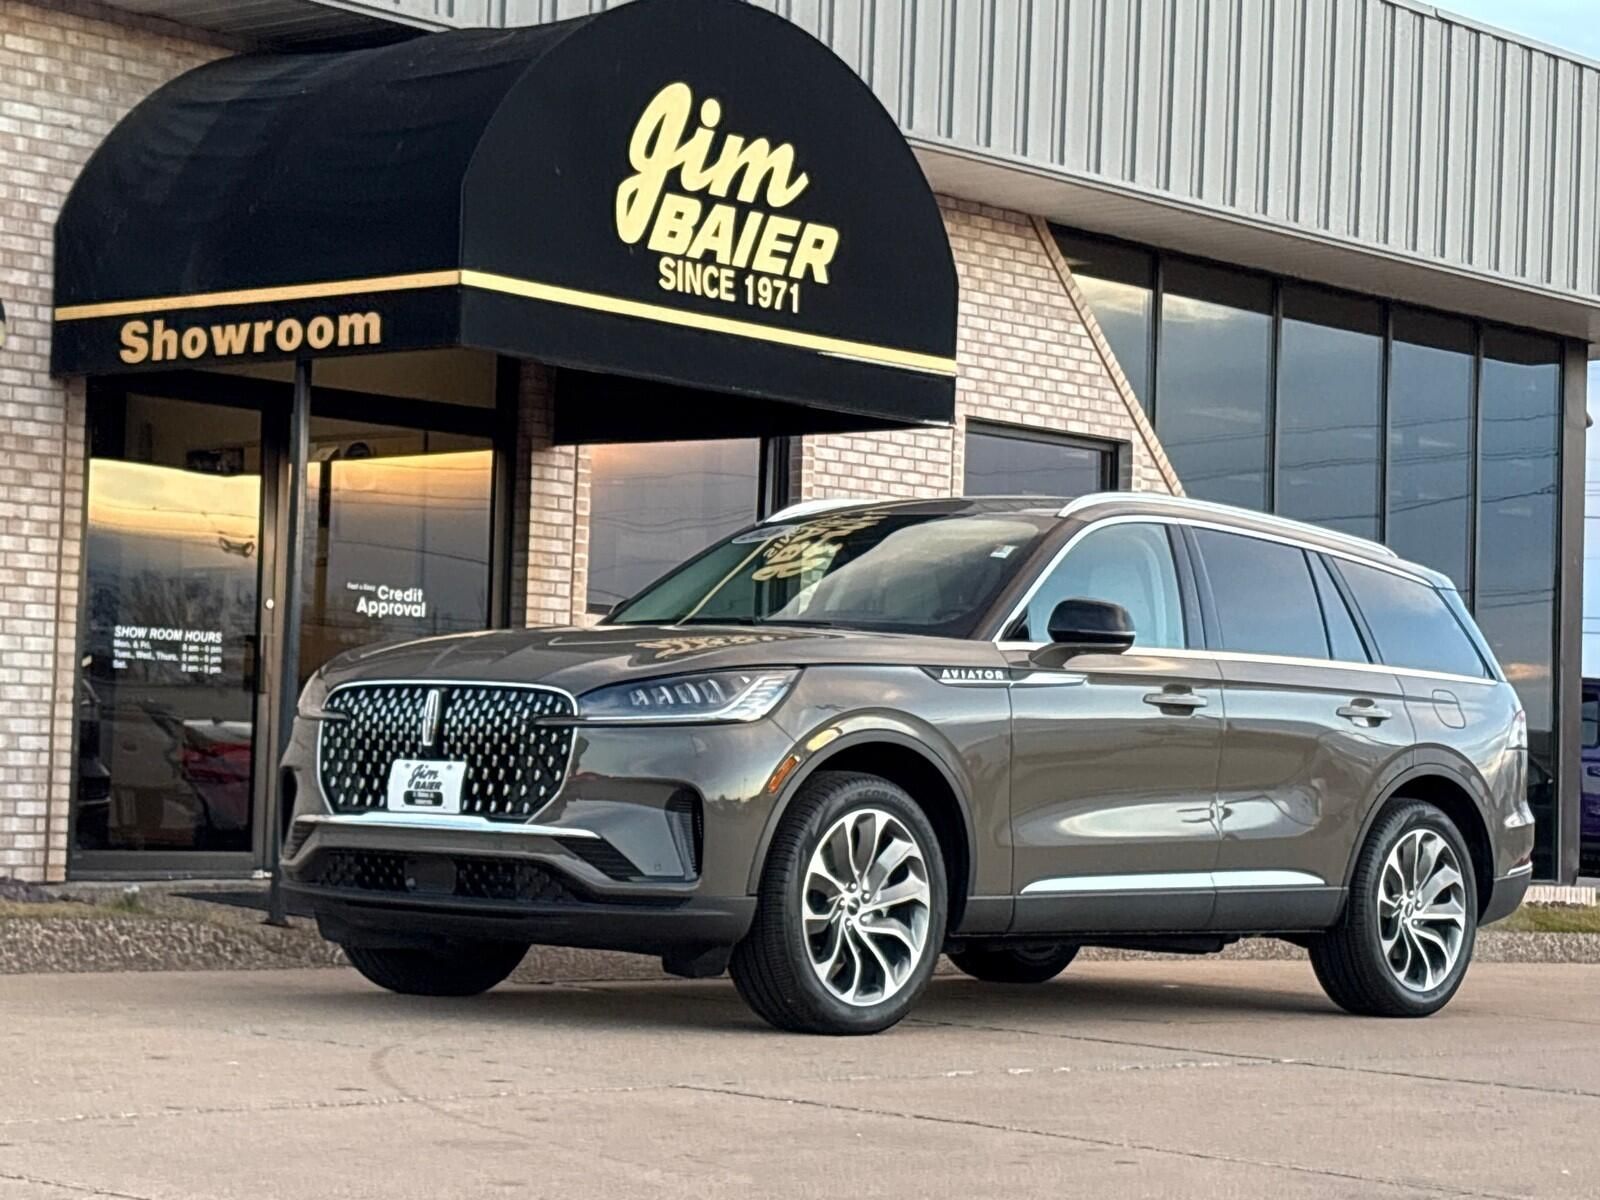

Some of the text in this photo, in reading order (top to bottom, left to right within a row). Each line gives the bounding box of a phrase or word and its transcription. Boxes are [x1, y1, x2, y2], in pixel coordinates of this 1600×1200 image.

[616, 82, 809, 244] Jim
[647, 193, 840, 284] BAIER
[659, 256, 799, 314] SINCE 1971
[119, 311, 381, 364] Showroom
[378, 585, 423, 602] Credit
[356, 596, 426, 618] Approval
[114, 625, 223, 644] SHOW ROOM HOURS
[941, 669, 1004, 680] AVIATOR
[408, 764, 439, 789] Jim
[414, 781, 442, 791] BAIER
